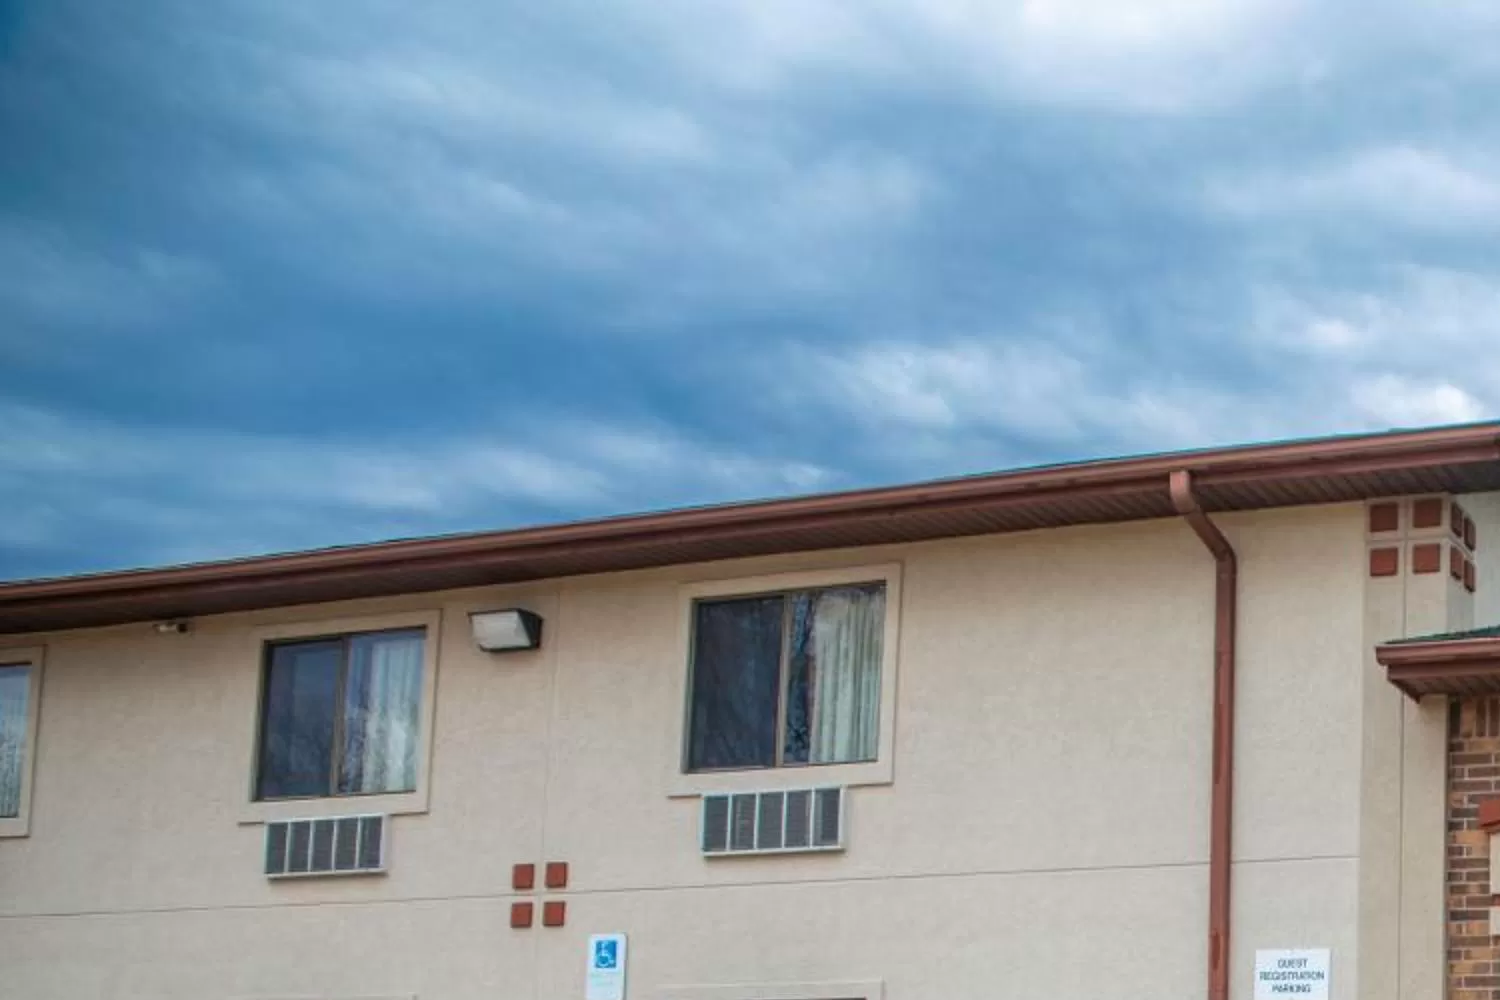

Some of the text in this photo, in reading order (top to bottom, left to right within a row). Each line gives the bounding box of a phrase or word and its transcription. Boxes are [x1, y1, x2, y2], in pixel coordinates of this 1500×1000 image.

[1277, 958, 1308, 969] GUEST
[1259, 971, 1325, 981] REGISTRATION
[1271, 984, 1312, 993] PARKING
